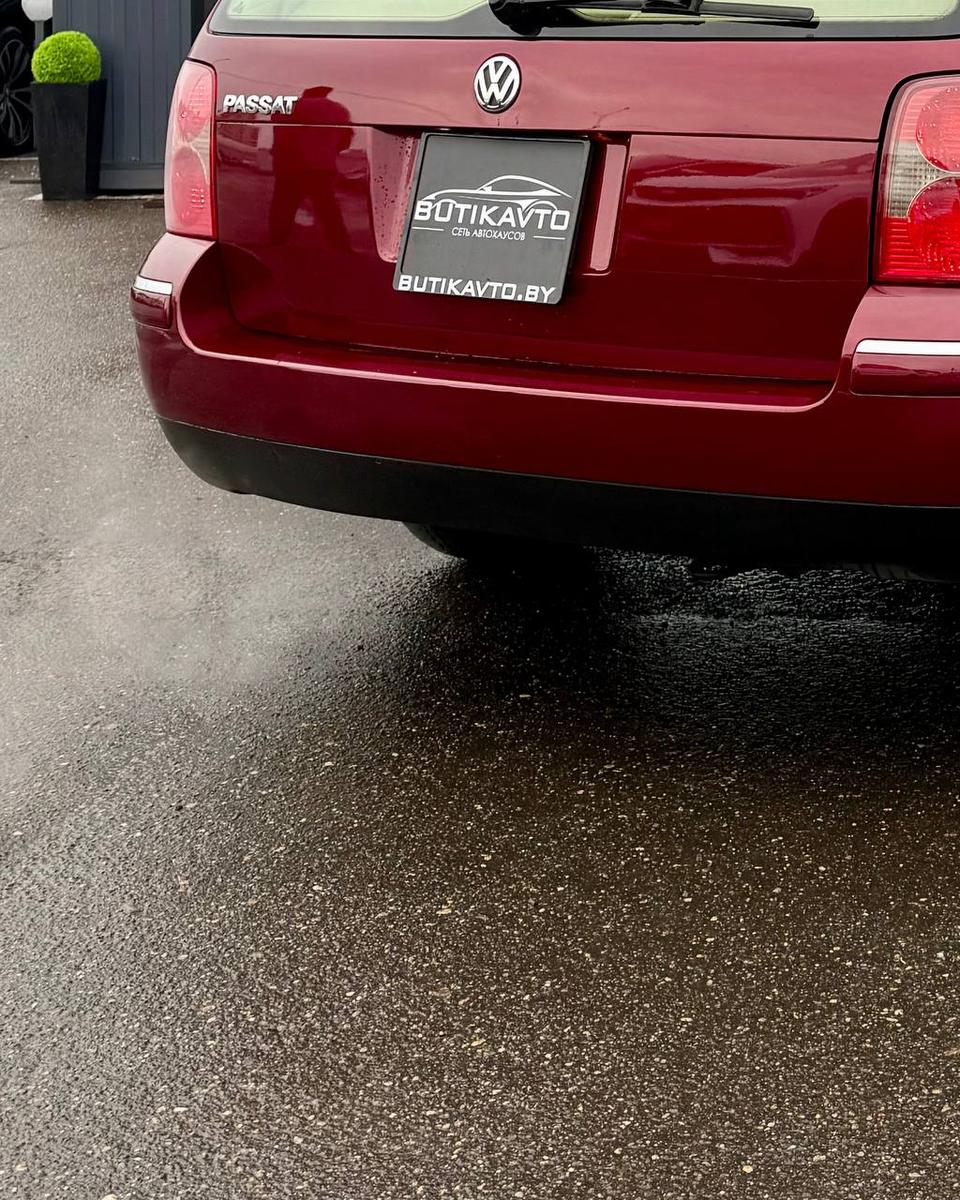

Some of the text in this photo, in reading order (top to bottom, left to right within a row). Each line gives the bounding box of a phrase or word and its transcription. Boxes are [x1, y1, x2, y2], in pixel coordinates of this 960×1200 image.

[222, 94, 298, 115] PASSAT
[413, 200, 570, 231] BUTIKAVTO
[451, 226, 526, 241] СЕТЬ АВТОХАУСОВ
[398, 274, 557, 303] BUTIKAVTO.BY
